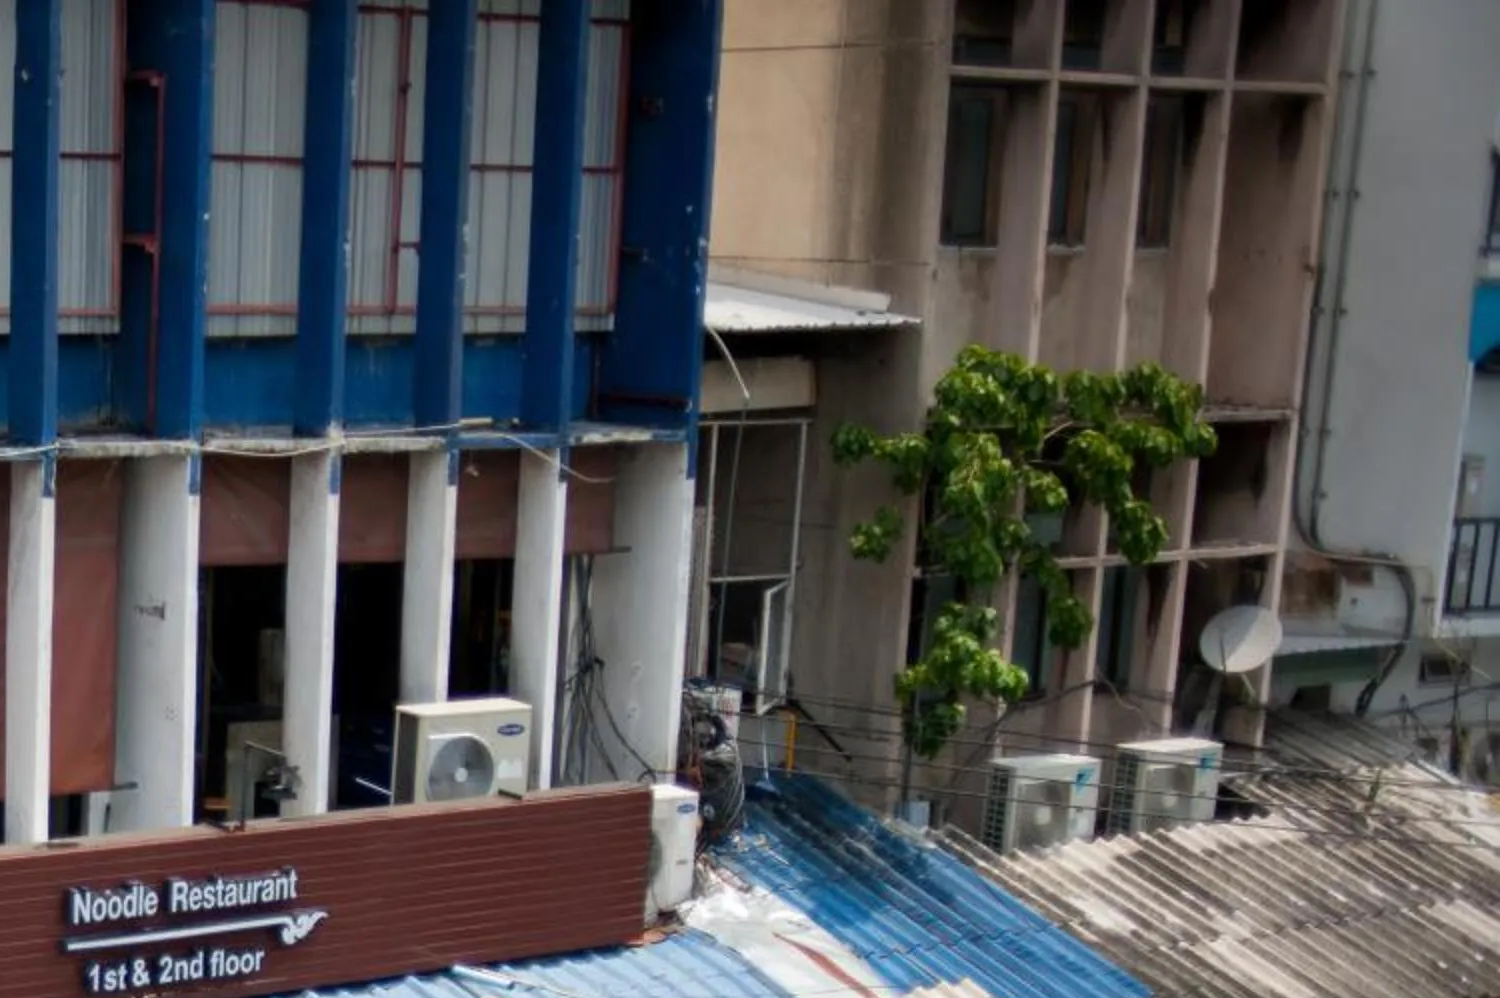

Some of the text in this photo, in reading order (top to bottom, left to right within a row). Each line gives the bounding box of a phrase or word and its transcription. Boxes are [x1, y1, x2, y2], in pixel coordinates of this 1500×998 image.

[72, 867, 298, 925] Noodle Restaurant
[88, 947, 265, 993] 1st & 2nd floor
